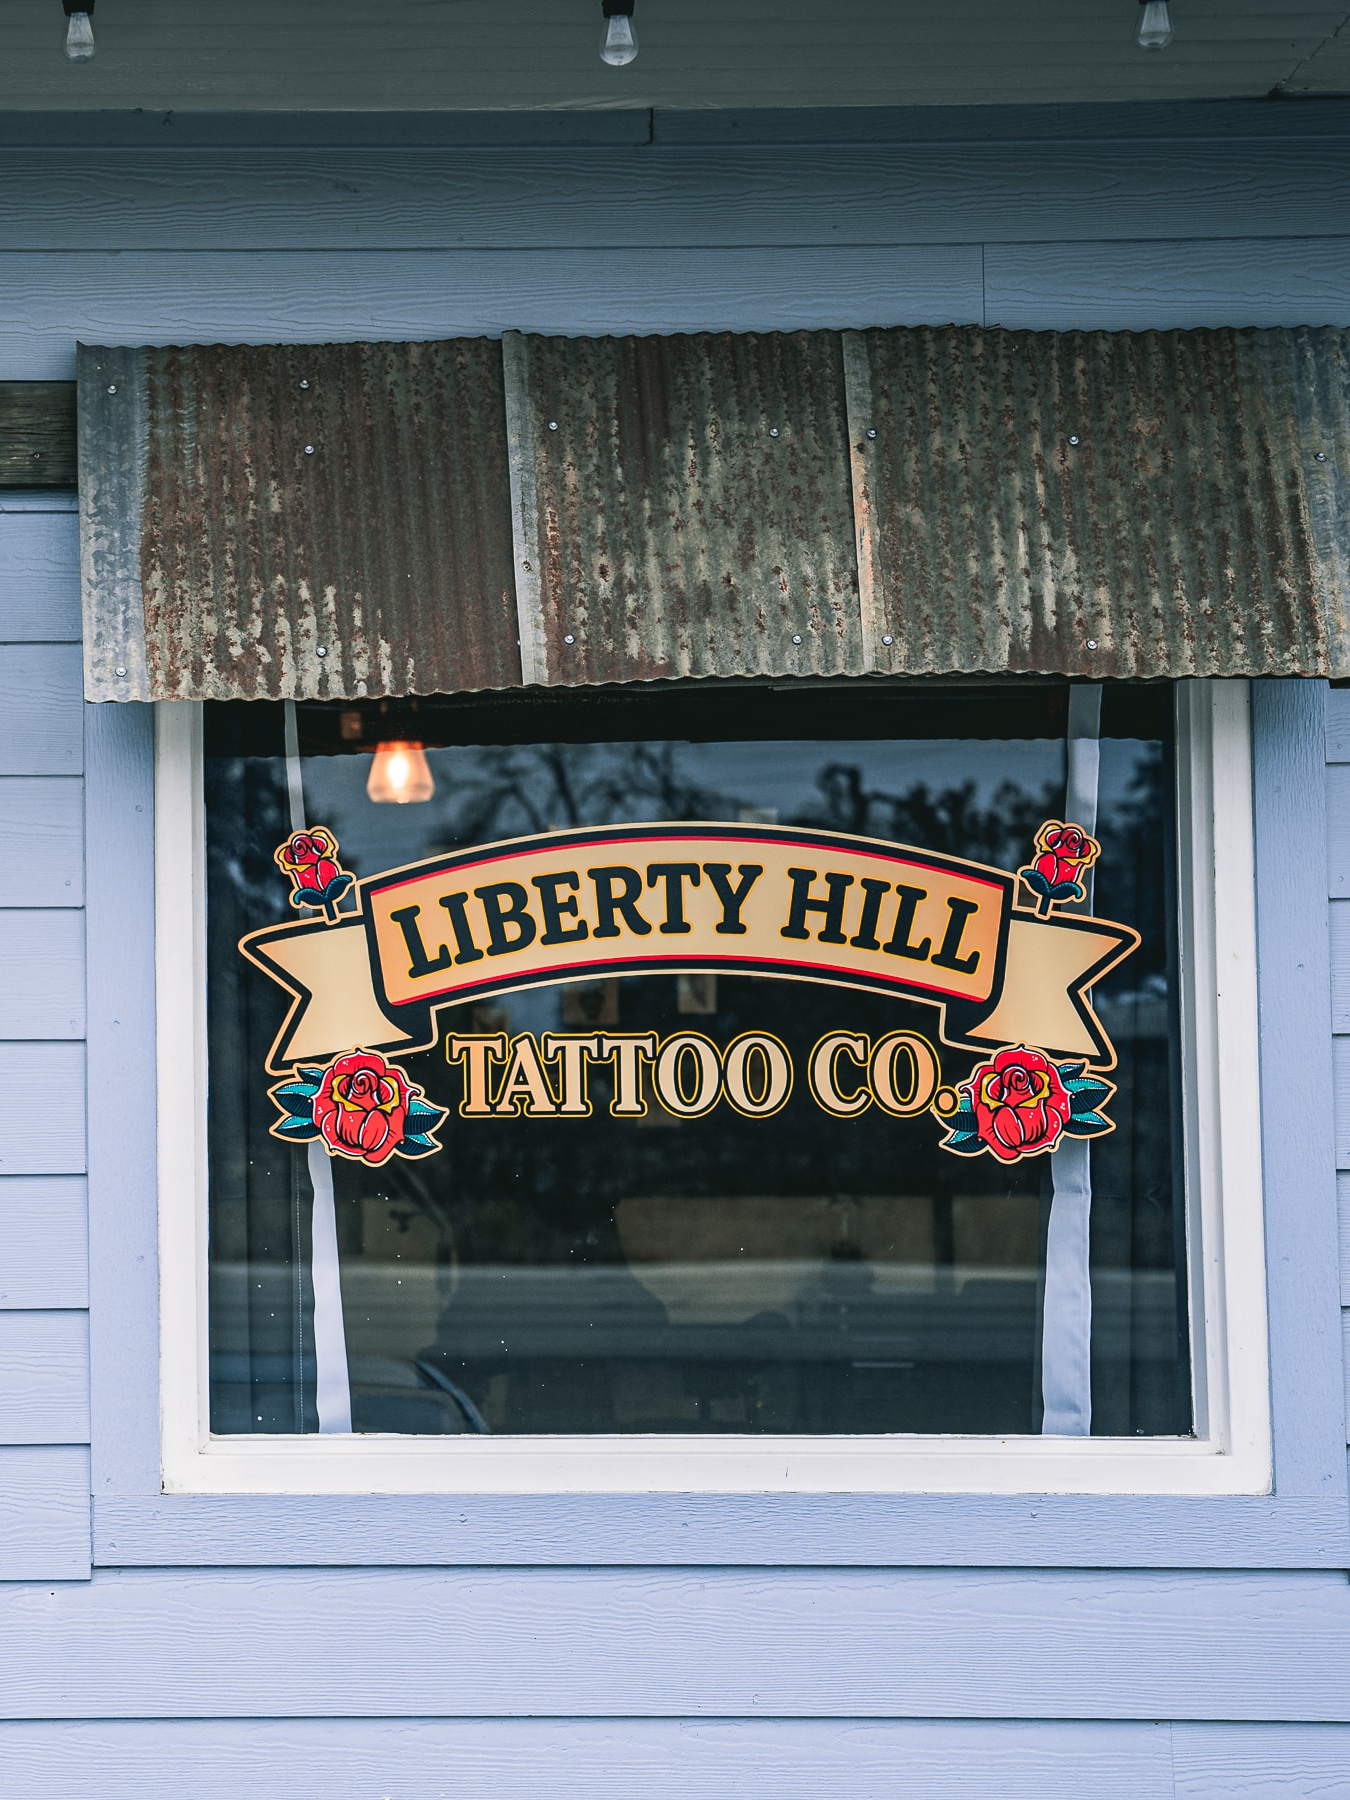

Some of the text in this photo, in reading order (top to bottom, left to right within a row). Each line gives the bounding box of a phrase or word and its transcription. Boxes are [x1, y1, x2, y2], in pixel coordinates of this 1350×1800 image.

[389, 862, 982, 980] LIBERTY HILL
[446, 1030, 960, 1119] TATTOO CO.
